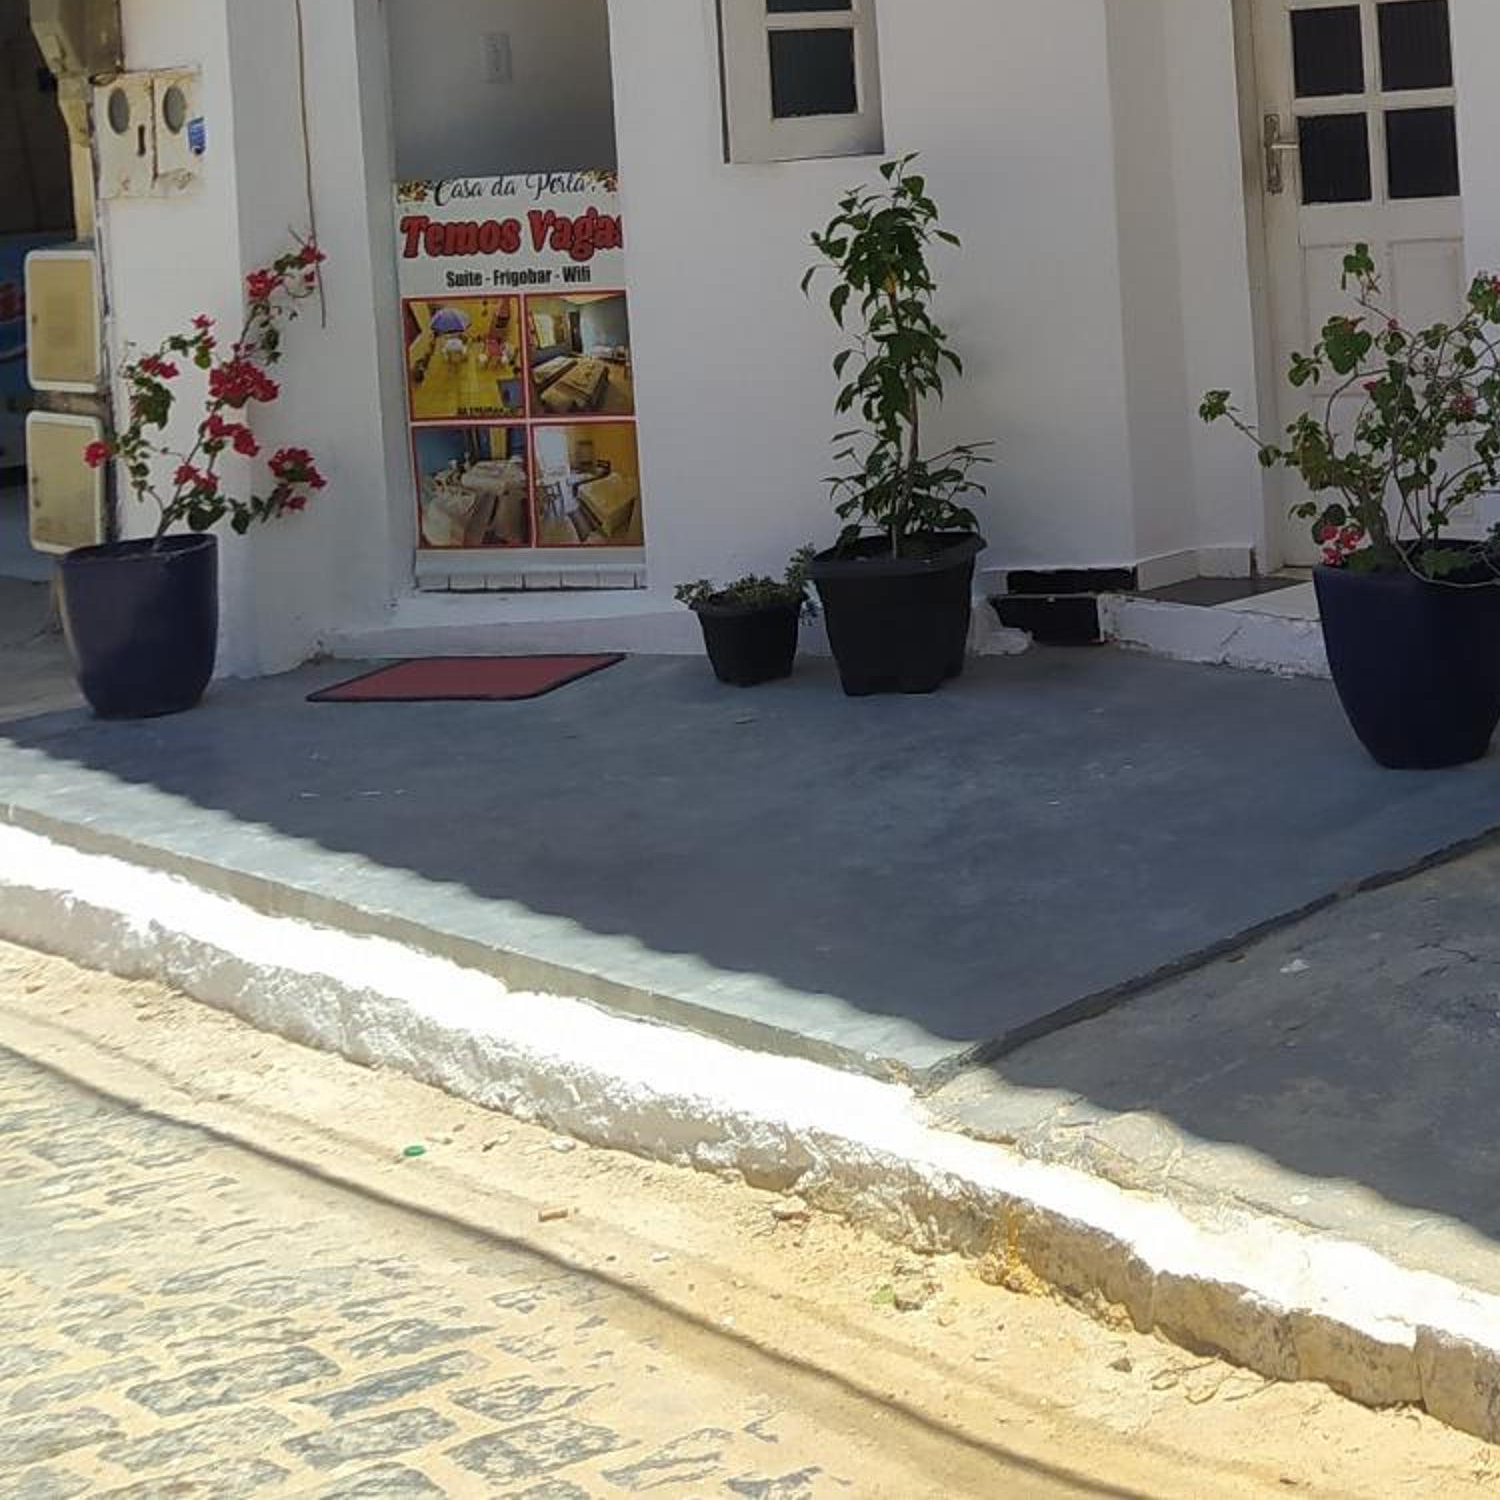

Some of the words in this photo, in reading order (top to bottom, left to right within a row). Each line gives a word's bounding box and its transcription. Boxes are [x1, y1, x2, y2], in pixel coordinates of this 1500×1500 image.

[432, 177, 482, 206] Casa
[491, 177, 517, 198] da
[400, 214, 522, 259] Temos
[446, 270, 483, 288] Suite
[493, 268, 552, 288] Frigobar
[562, 265, 592, 284] Wifi
